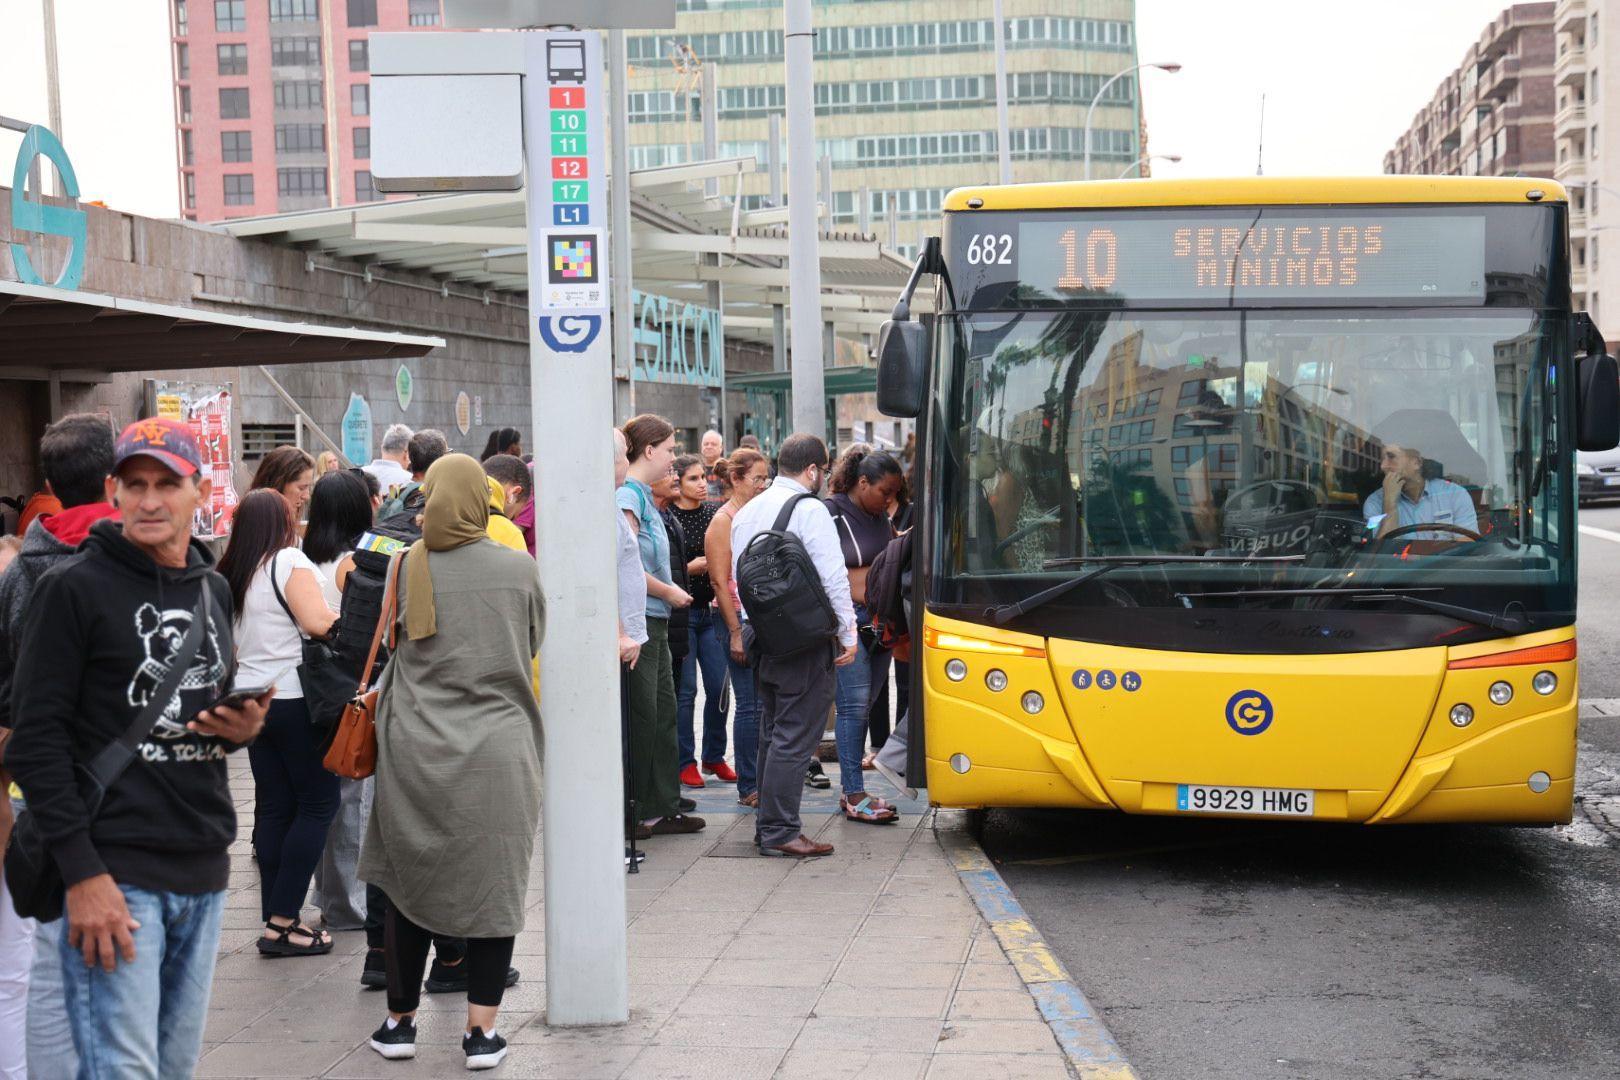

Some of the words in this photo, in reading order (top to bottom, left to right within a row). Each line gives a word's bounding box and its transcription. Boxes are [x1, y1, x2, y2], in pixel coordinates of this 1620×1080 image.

[562, 91, 571, 106] 1
[558, 114, 580, 130] 10
[559, 137, 577, 153] 11
[560, 161, 581, 176] 12
[560, 184, 582, 199] 17
[560, 207, 581, 222] L1
[967, 234, 1013, 265] 682
[1057, 227, 1118, 288] 10
[1173, 225, 1385, 257] SERVICIOS
[1196, 257, 1359, 287] MINIMOS
[132, 420, 171, 446] NY
[1193, 788, 1255, 810] 9929
[1262, 790, 1308, 813] HMG
